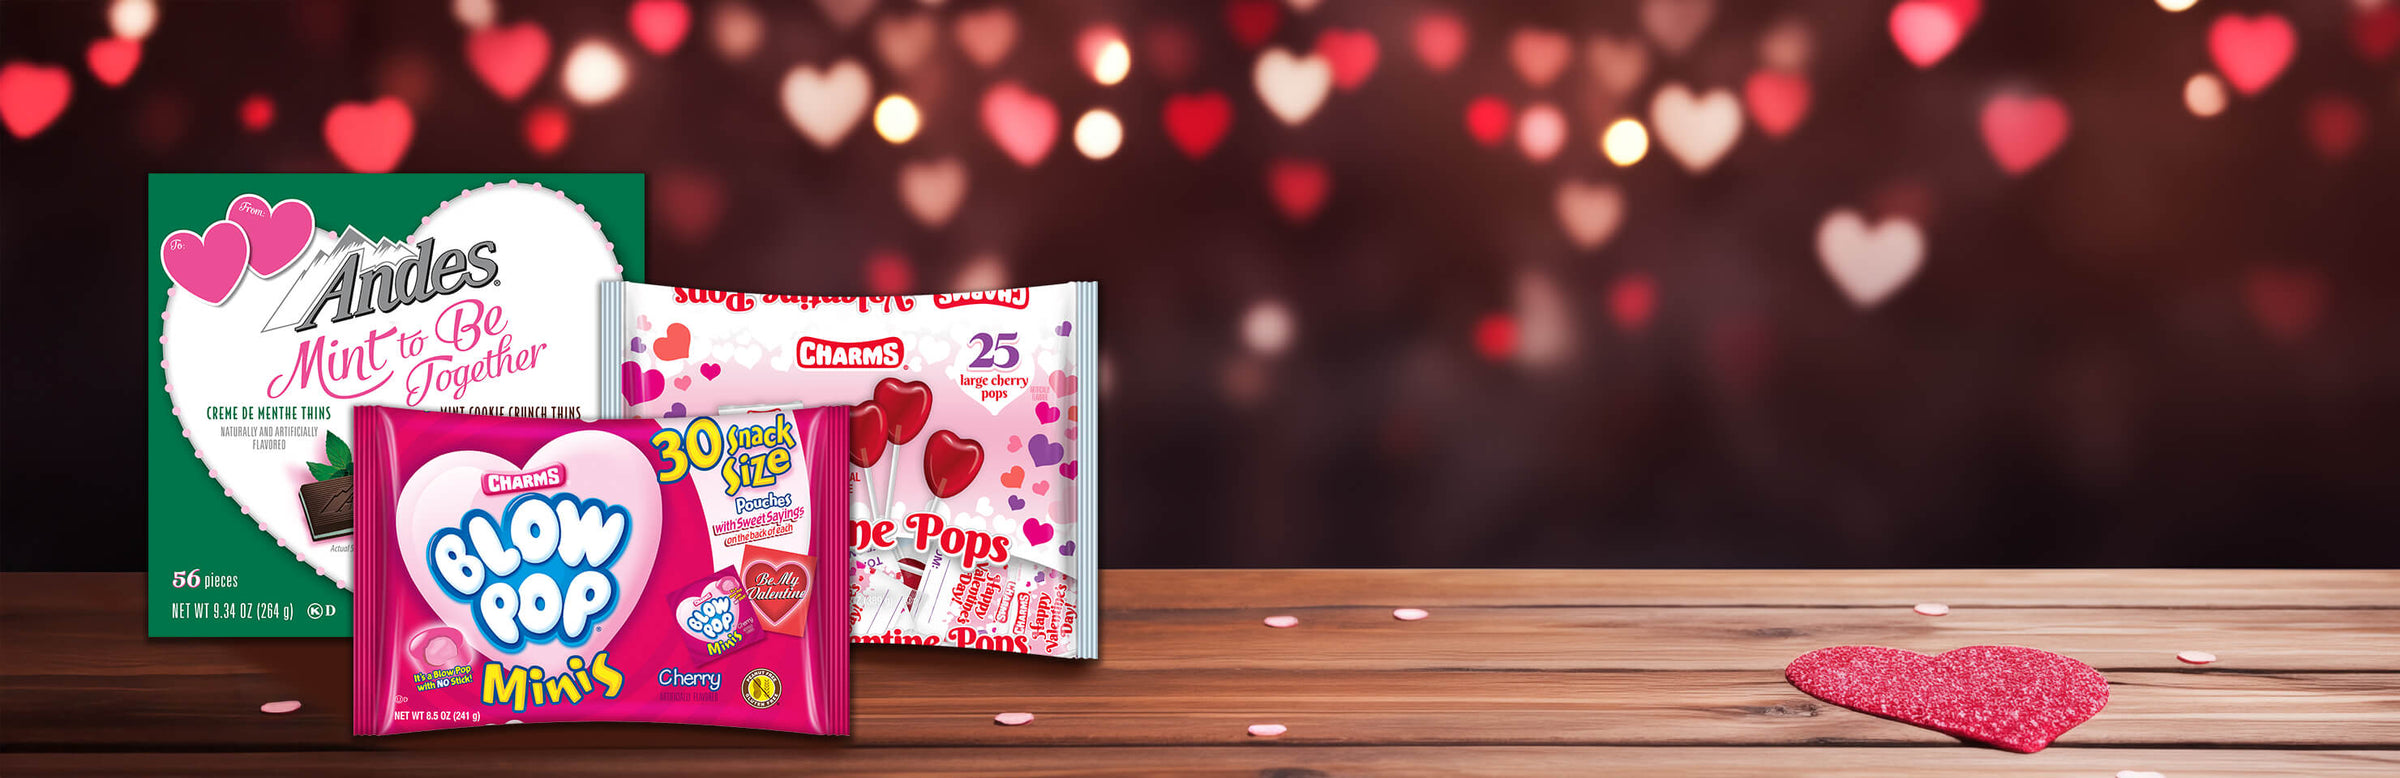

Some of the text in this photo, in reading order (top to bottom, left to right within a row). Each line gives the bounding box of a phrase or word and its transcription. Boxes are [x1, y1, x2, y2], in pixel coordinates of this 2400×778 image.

[239, 201, 265, 217] From:
[170, 239, 186, 251] To:
[294, 237, 499, 333] Andes
[266, 299, 508, 400] Mint to Be
[800, 341, 899, 366] CHARMS
[968, 332, 1021, 370] 25
[406, 333, 547, 407] Together
[960, 374, 1029, 389] large cherry
[981, 389, 1008, 402] pops
[207, 406, 331, 420] CREME DE MENTHE THINS
[469, 406, 505, 417] COOKIE
[509, 406, 547, 418] CRUNCH
[551, 406, 581, 419] THINS
[220, 426, 318, 437] NATURALLY AND ARTIFICIALLY
[252, 439, 286, 450] FLAVORED
[650, 416, 724, 484] 30
[488, 466, 560, 493] CHARMS
[721, 447, 792, 497] Size
[735, 492, 792, 514] Pouches
[714, 506, 804, 535] with Sweet Sayings
[727, 523, 793, 546] on the back of each
[906, 513, 1009, 569] Pops
[330, 544, 350, 553] Actual
[431, 496, 629, 599] BLOW
[172, 568, 238, 590] 56 pieces
[755, 572, 799, 588] Be My
[952, 573, 972, 605] Day!
[745, 586, 805, 600] Valentine
[975, 573, 1001, 620] Happy
[172, 603, 294, 621] NET WT 9.34 OZ (264 g)
[475, 567, 616, 650] POP
[687, 597, 731, 632] BLOW
[1015, 594, 1029, 633] CHARMS
[1030, 592, 1052, 640] Happy
[1060, 602, 1077, 637] Day!
[702, 612, 735, 639] POP
[706, 630, 743, 656] Minis
[413, 665, 472, 683] It's a Blow Pop
[416, 674, 473, 692] with NO Stick!
[481, 650, 625, 713] Minis
[658, 667, 722, 691] Cherry
[394, 711, 481, 722] NET WT 8.5 OZ (241 g)
